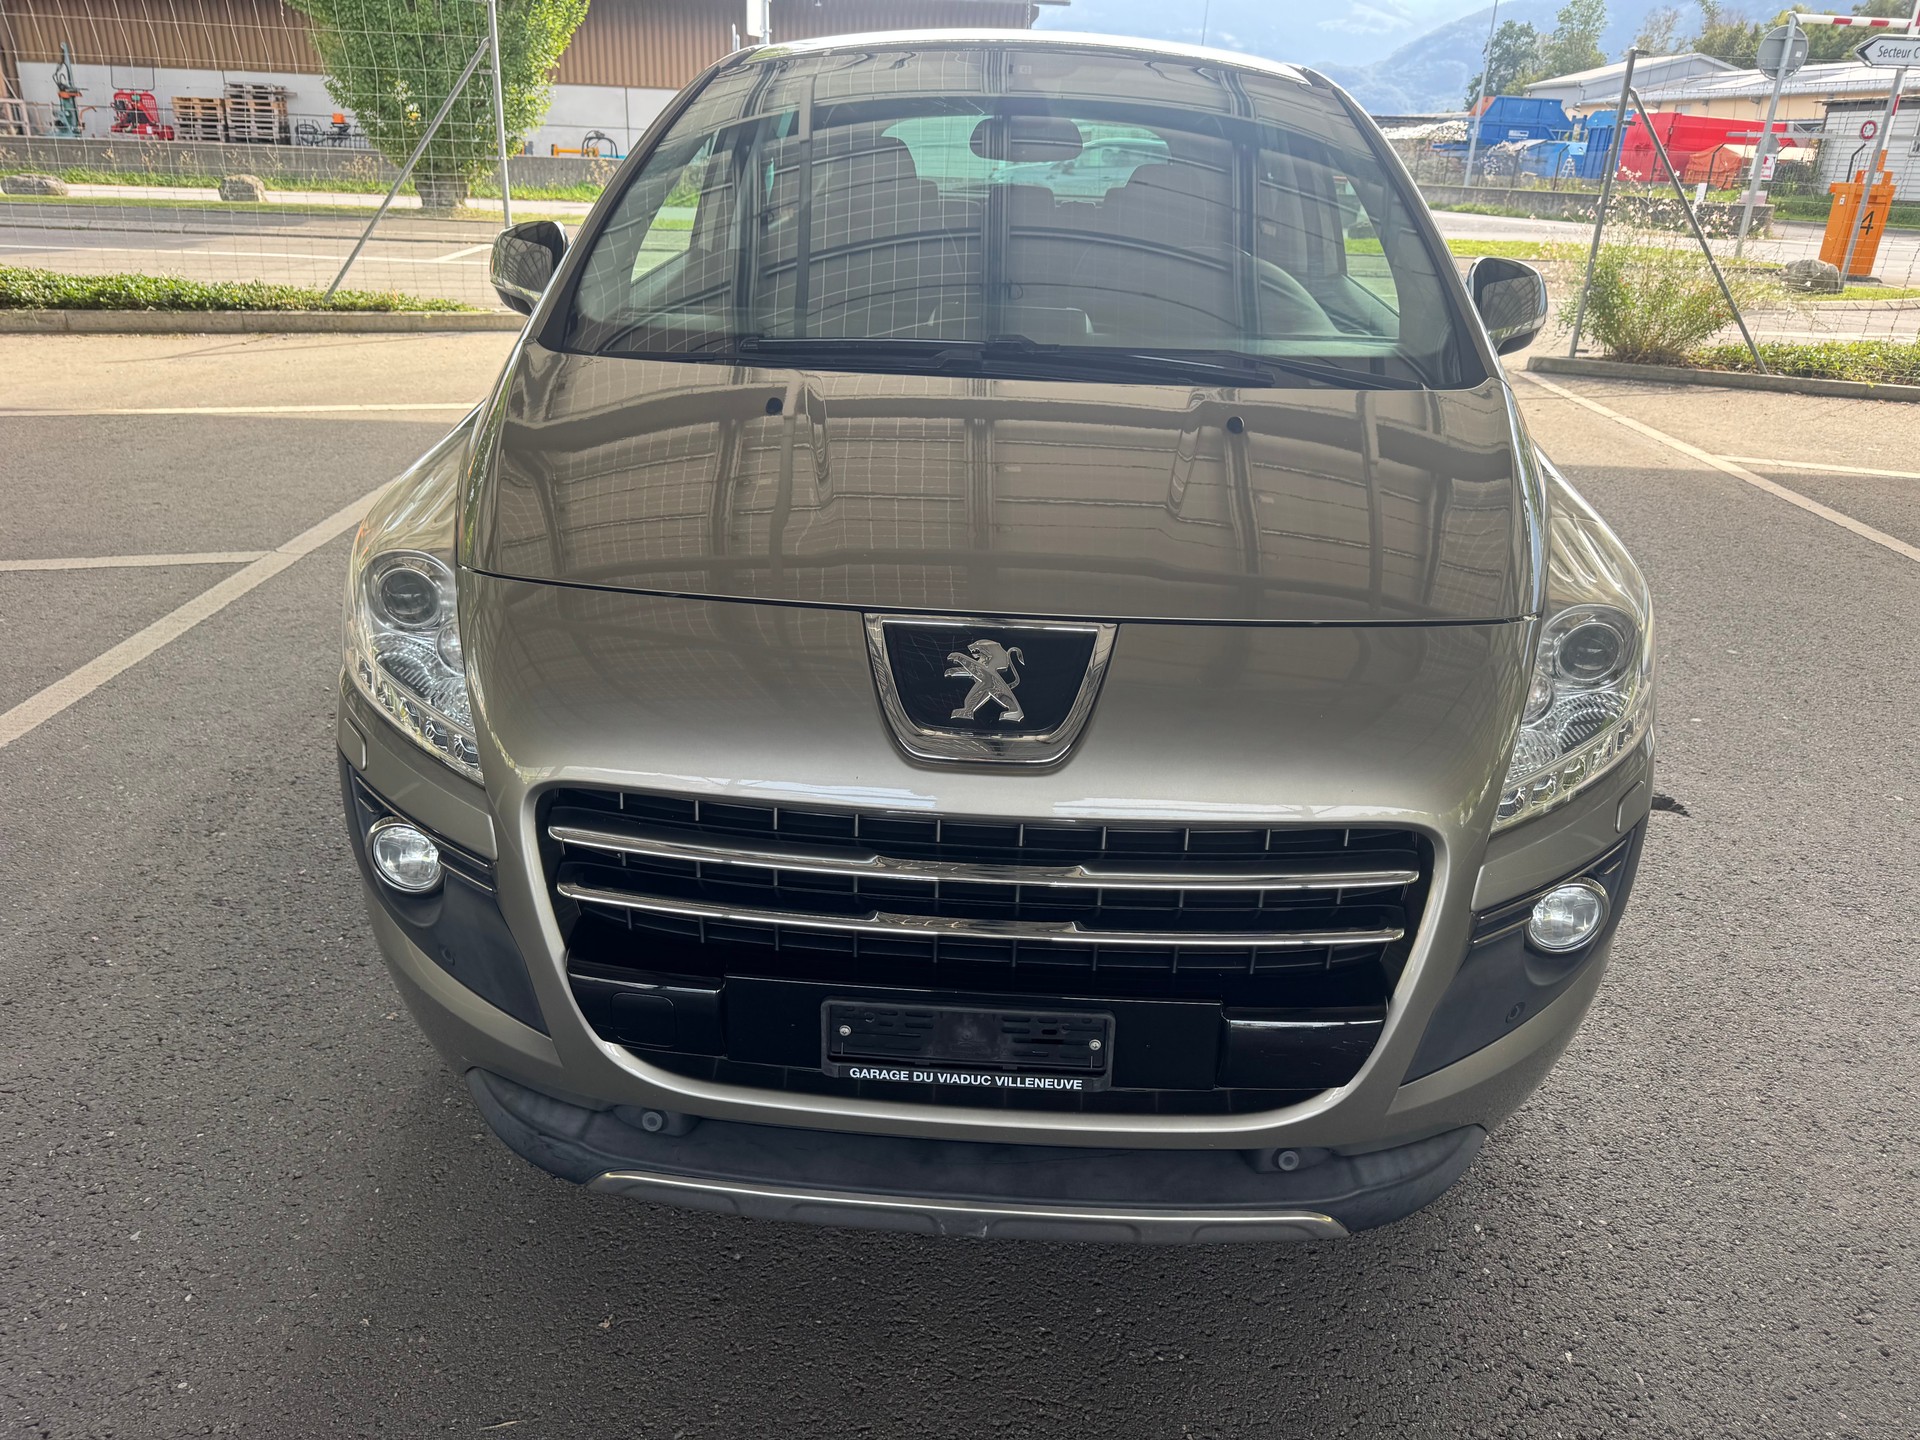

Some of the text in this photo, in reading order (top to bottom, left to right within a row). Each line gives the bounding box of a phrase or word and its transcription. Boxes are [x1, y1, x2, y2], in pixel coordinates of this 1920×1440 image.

[1877, 45, 1912, 59] Secteur
[1860, 210, 1874, 236] 4
[849, 1067, 1083, 1090] GARAGE DU VIADUC VILLENEUVE
